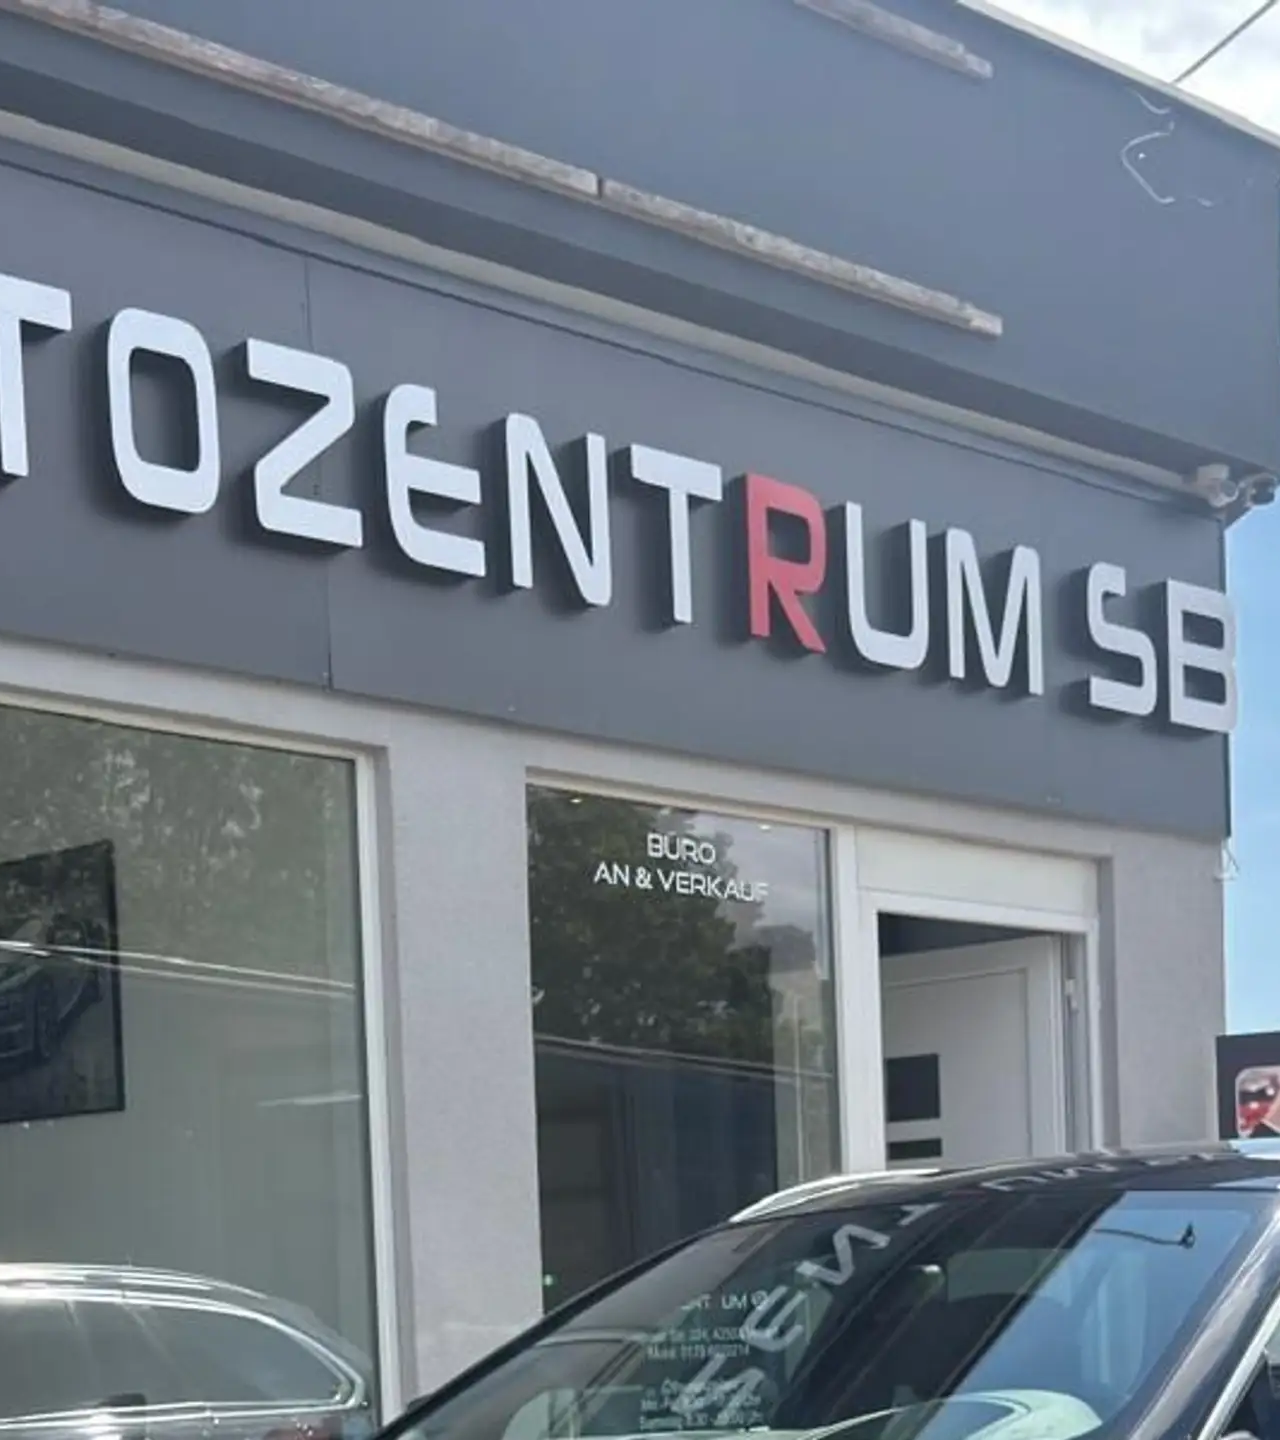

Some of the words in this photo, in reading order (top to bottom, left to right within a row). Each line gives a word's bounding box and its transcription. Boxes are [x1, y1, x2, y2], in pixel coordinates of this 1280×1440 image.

[1086, 562, 1238, 734] SB
[646, 831, 716, 865] BÜRO
[594, 861, 630, 888] AN
[635, 868, 652, 889] &
[657, 869, 769, 901] VERKAUF
